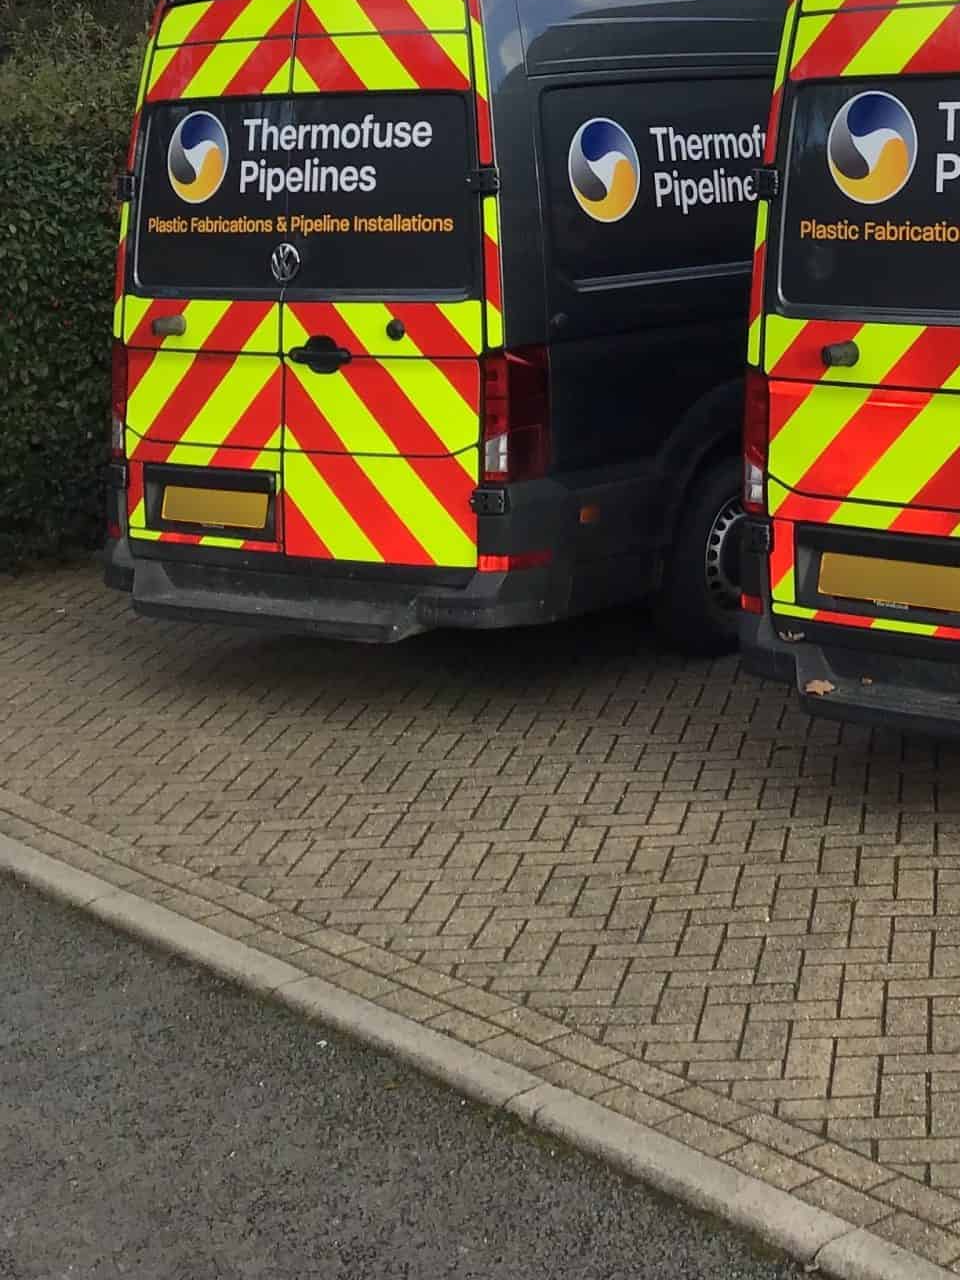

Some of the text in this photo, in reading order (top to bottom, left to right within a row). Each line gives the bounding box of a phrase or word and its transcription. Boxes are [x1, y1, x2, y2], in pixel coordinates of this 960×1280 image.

[244, 114, 432, 152] Thermofuse
[240, 159, 377, 200] Pipelines
[148, 213, 454, 237] Plastic Fabrications & Pipeline Installations
[800, 220, 859, 242] Plastic
